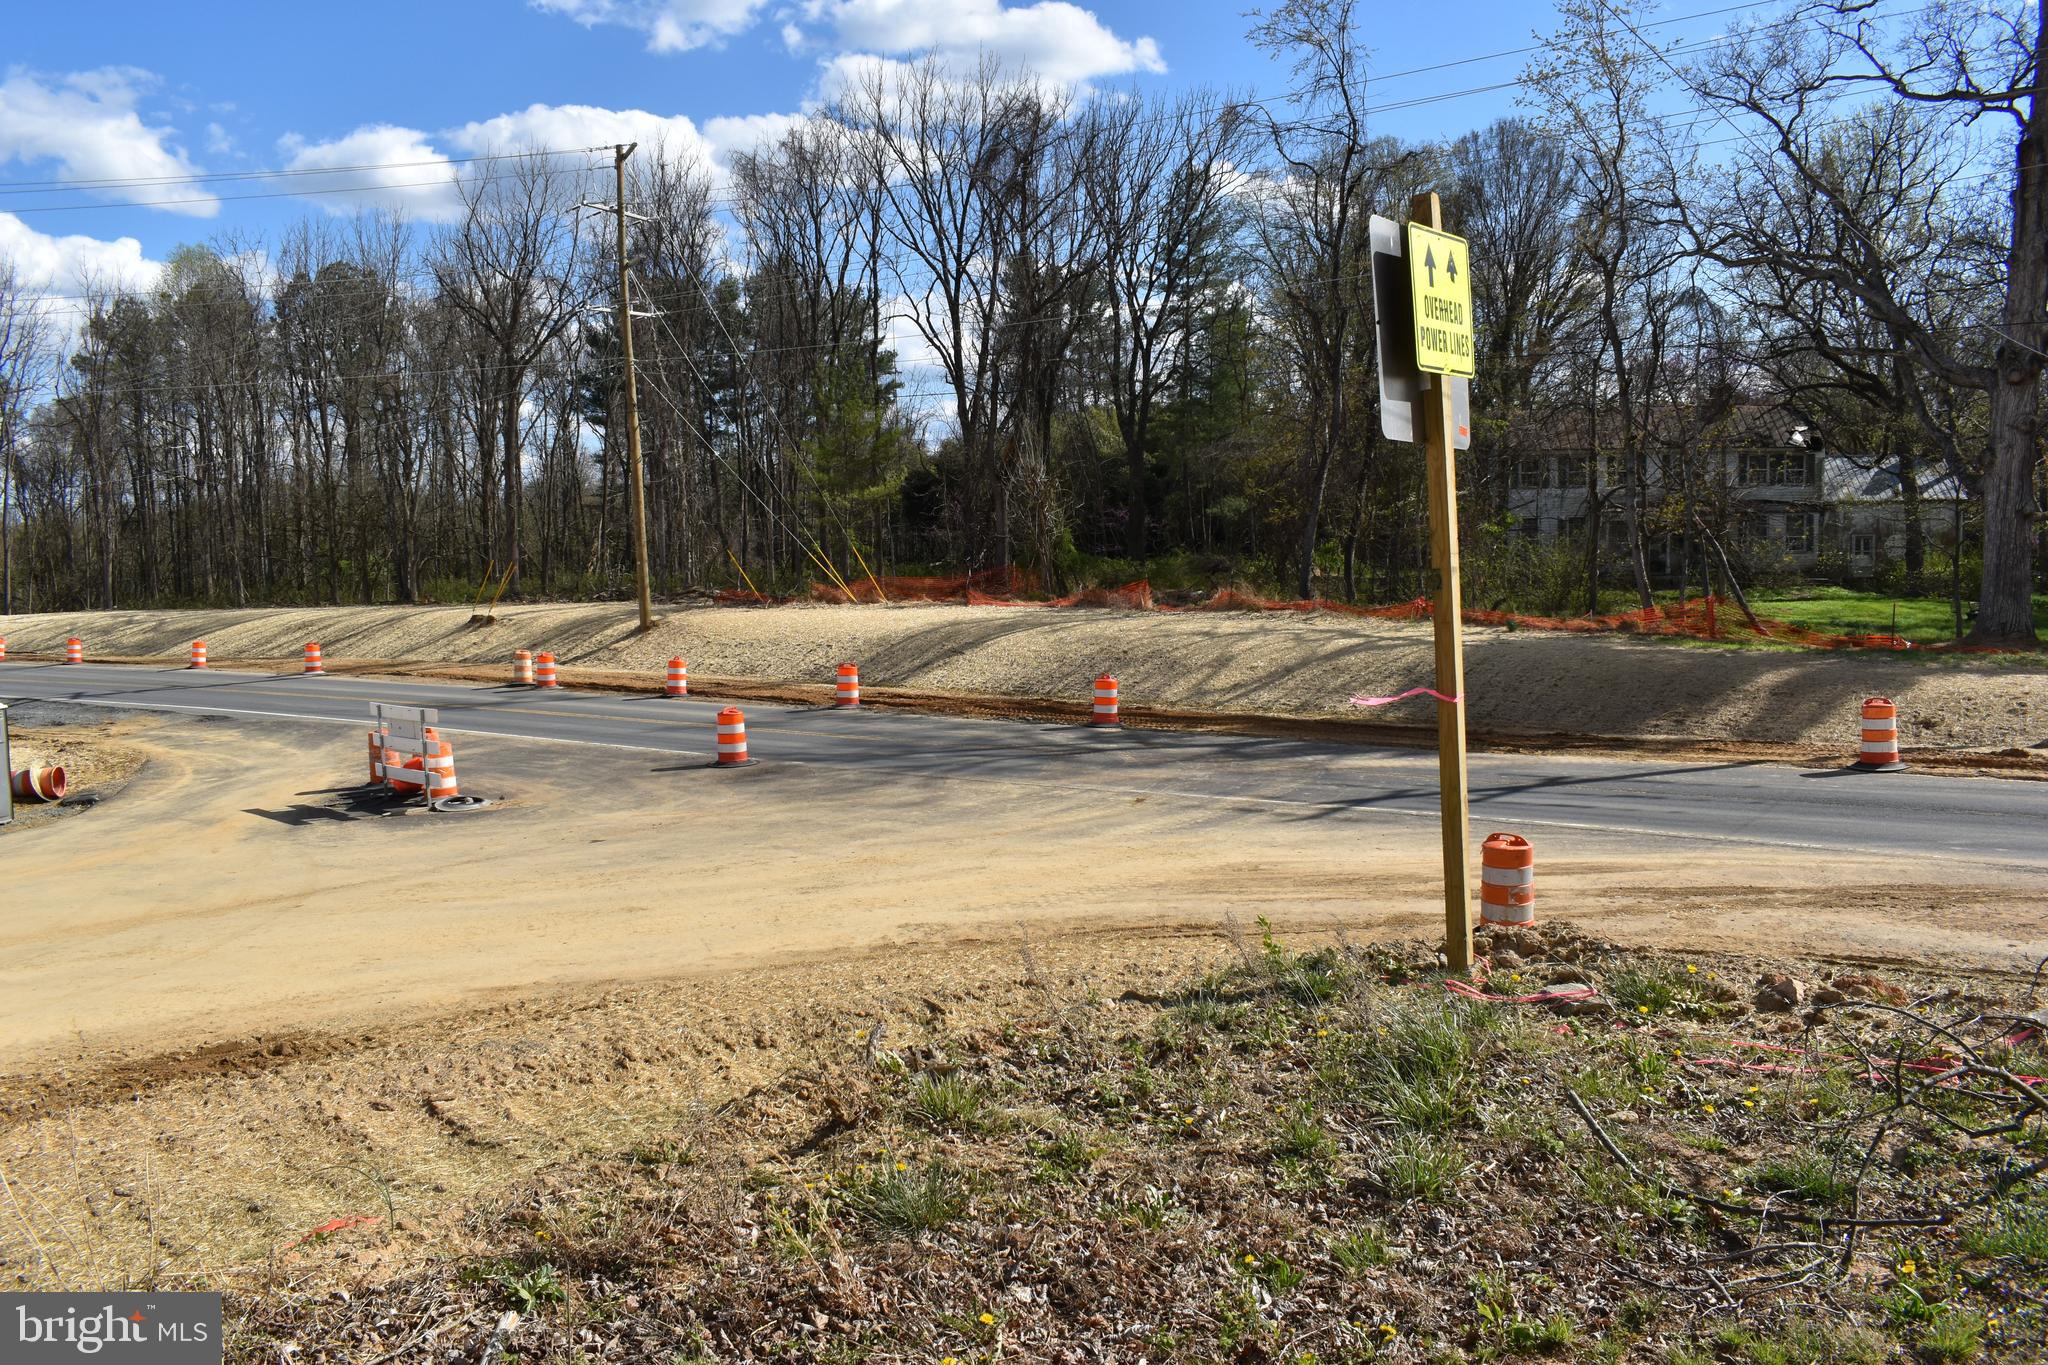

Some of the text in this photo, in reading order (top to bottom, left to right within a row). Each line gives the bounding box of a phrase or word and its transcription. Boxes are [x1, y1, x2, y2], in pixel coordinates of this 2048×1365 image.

[1424, 294, 1463, 325] OVERHEAD
[1420, 326, 1469, 358] POWER LINES
